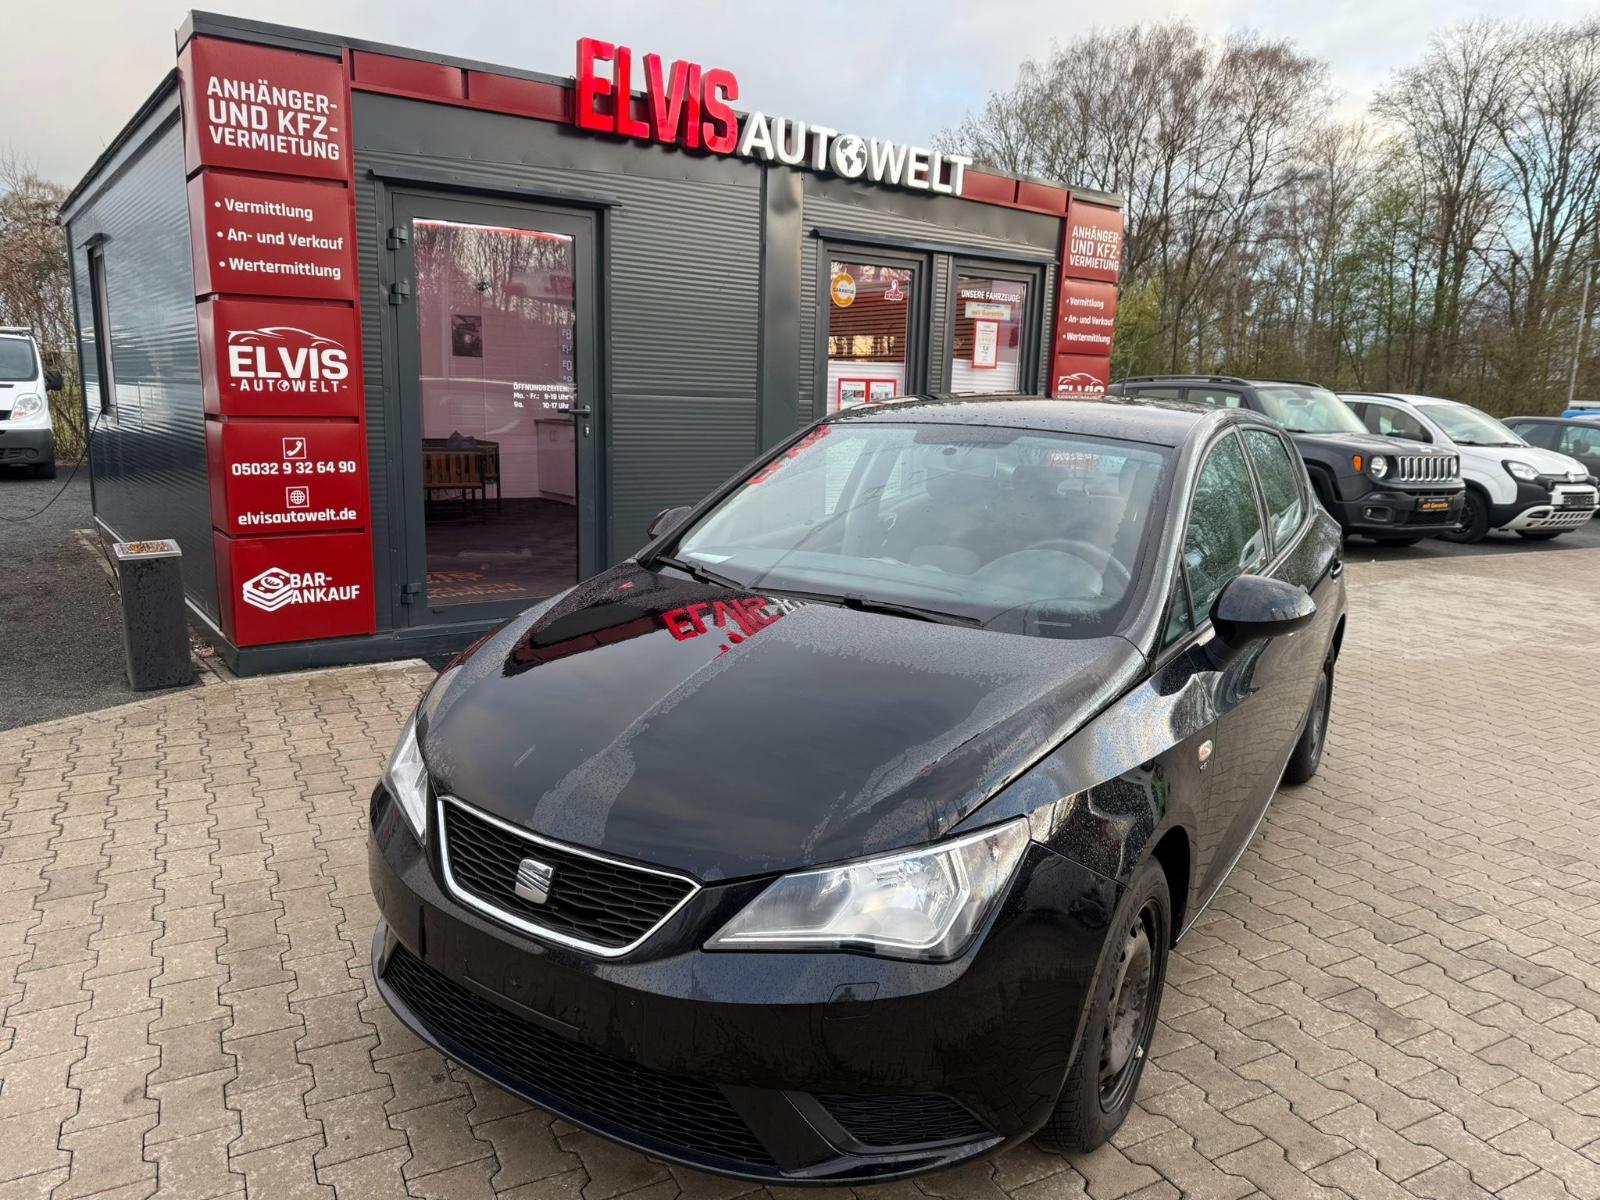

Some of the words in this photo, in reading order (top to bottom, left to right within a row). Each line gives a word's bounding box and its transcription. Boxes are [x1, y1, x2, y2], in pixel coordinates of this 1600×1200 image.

[207, 76, 338, 114] ANHÄNGER-
[208, 98, 268, 130] UND
[278, 109, 339, 140] KFZ-
[576, 37, 739, 154] ELVIS
[736, 111, 973, 197] AUTOWELT
[209, 125, 340, 160] VERMIETUNG
[224, 198, 313, 222] Vermittlung
[227, 228, 252, 242] An-
[256, 232, 285, 245] und
[288, 233, 343, 250] Verkauf
[1071, 238, 1094, 256] UND
[1096, 242, 1120, 259] KFZ-
[229, 257, 341, 280] Wertermittlung
[1070, 254, 1120, 271] VERMIETUNG
[961, 289, 985, 299] UNSERE
[1070, 297, 1105, 310] Vermittlung
[1068, 315, 1079, 324] An-
[1079, 317, 1091, 325] und
[1092, 318, 1114, 327] Verkauf
[1066, 332, 1111, 345] Wertermittlung
[228, 345, 349, 380] ELVIS
[231, 463, 279, 476] 05032
[282, 462, 292, 474] 9
[296, 461, 313, 474] 32
[317, 461, 335, 473] 64
[338, 461, 356, 473] 90
[238, 508, 357, 525] elvisautowelt.de
[290, 572, 333, 588] BAR-
[291, 585, 360, 604] ANKAUF
